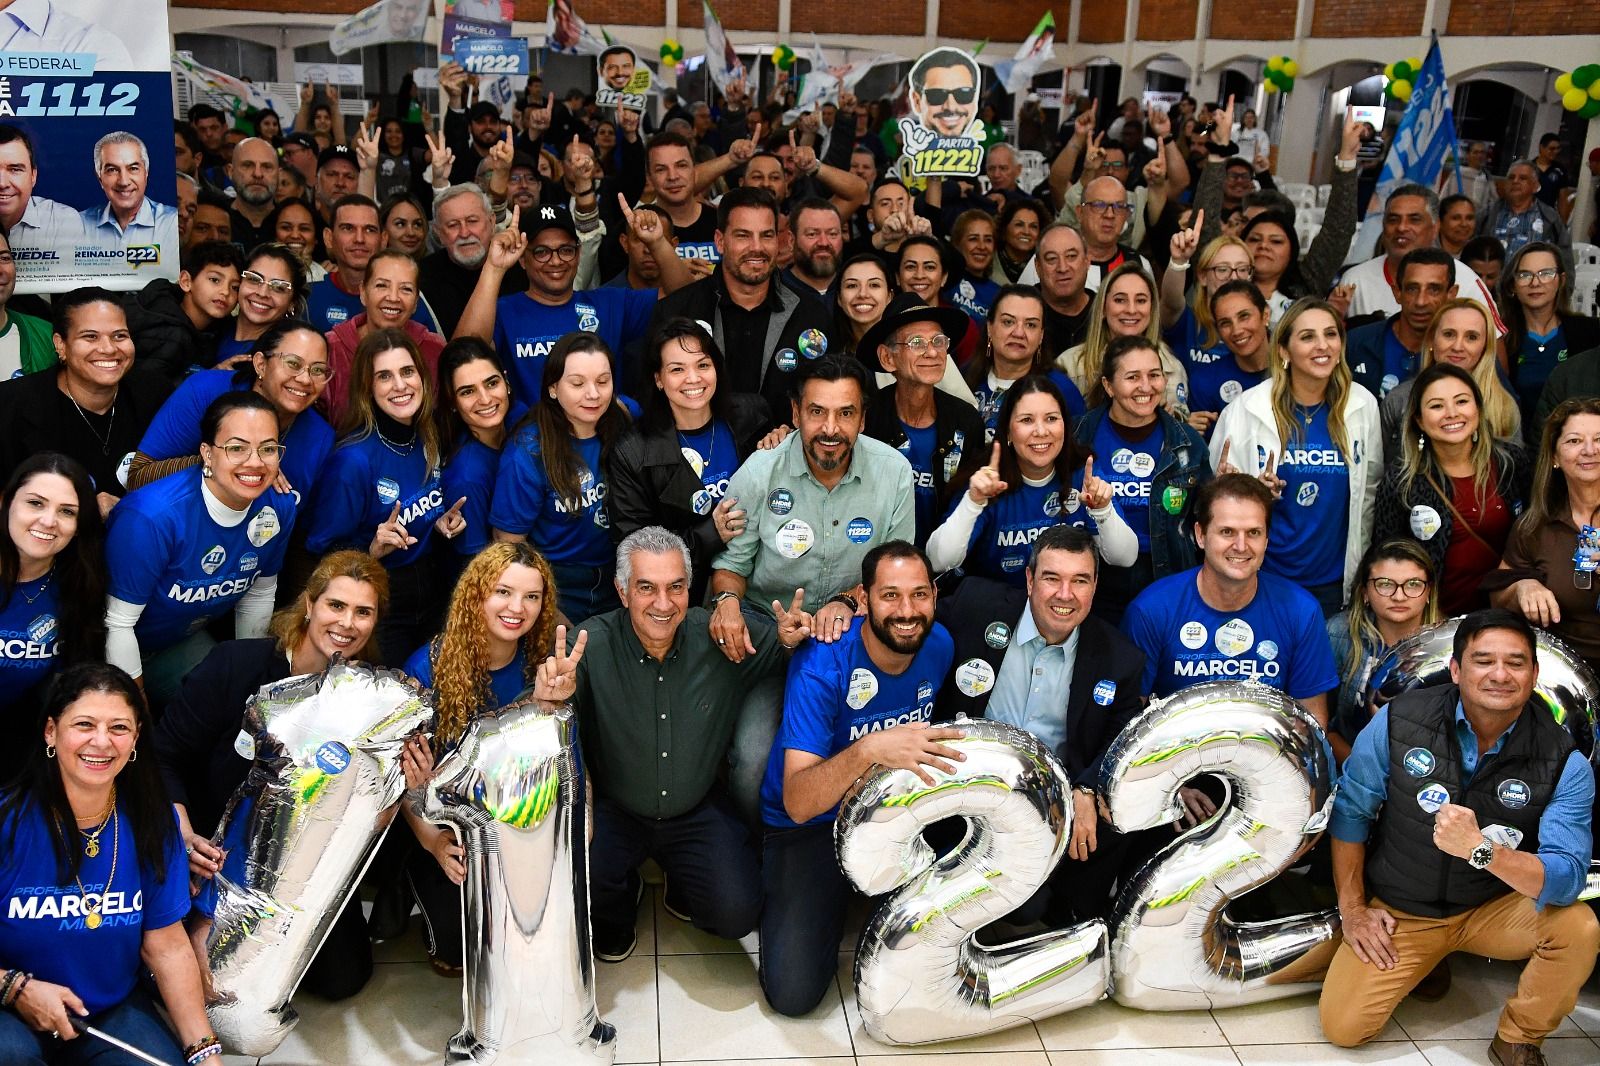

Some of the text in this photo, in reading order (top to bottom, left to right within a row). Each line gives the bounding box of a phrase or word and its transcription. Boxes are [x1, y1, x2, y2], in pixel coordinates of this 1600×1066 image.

[455, 24, 497, 36] MARCELO
[9, 57, 82, 70] FEDERAL
[465, 54, 520, 73] 11222
[16, 82, 140, 116] 1112
[937, 138, 971, 148] PARTIU
[915, 148, 979, 173] 11222!
[541, 207, 556, 219] NY
[11, 251, 60, 260] RIEDEL
[128, 249, 157, 260] 222
[847, 528, 872, 536] 11222
[240, 563, 258, 572] 11222
[1001, 558, 1024, 568] 11222
[1173, 659, 1280, 678] MARCELO
[849, 702, 933, 741] MARCELO
[850, 706, 911, 725] PROFESSOR
[317, 748, 347, 771] 11222
[14, 883, 104, 895] PROFESSOR
[58, 911, 143, 931] MIAND
